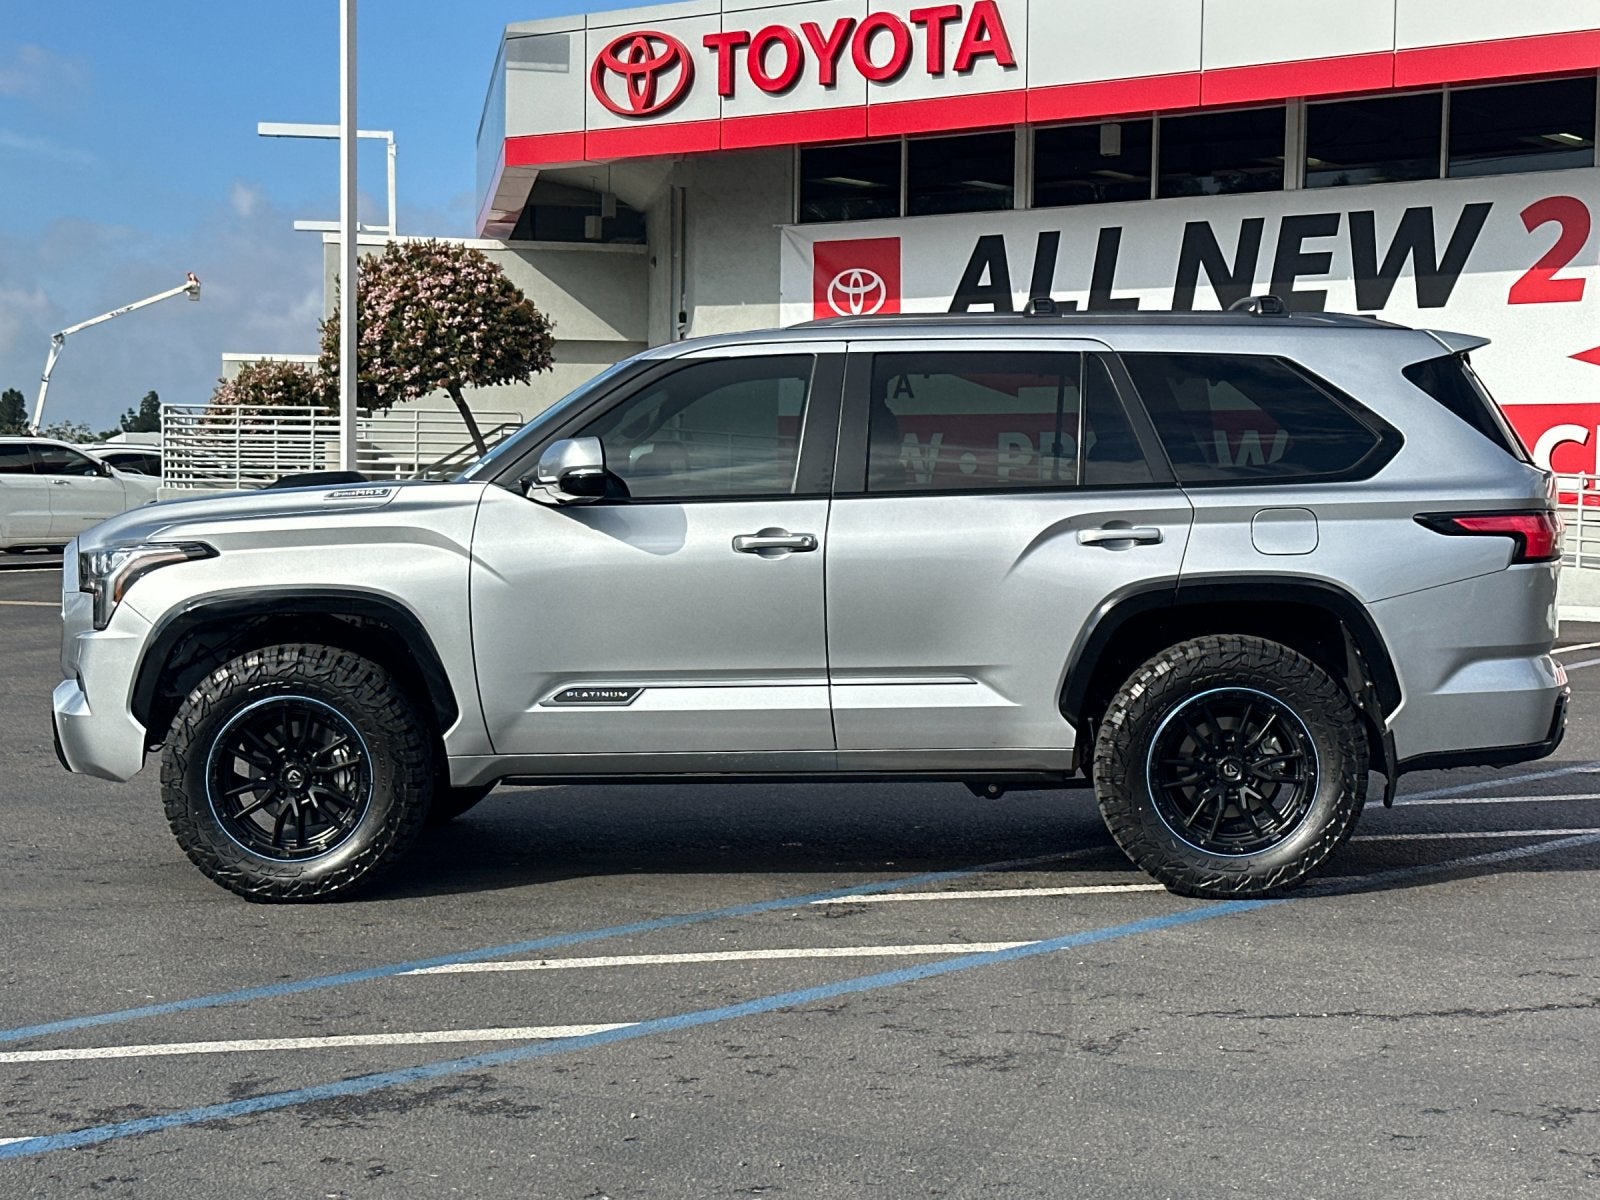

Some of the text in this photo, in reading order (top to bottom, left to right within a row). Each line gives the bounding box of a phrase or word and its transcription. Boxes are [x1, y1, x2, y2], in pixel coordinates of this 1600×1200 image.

[703, 0, 1018, 97] TOYOTA
[947, 226, 1140, 313] ALL
[1171, 201, 1494, 312] NEW
[565, 690, 629, 698] PLATINUM
